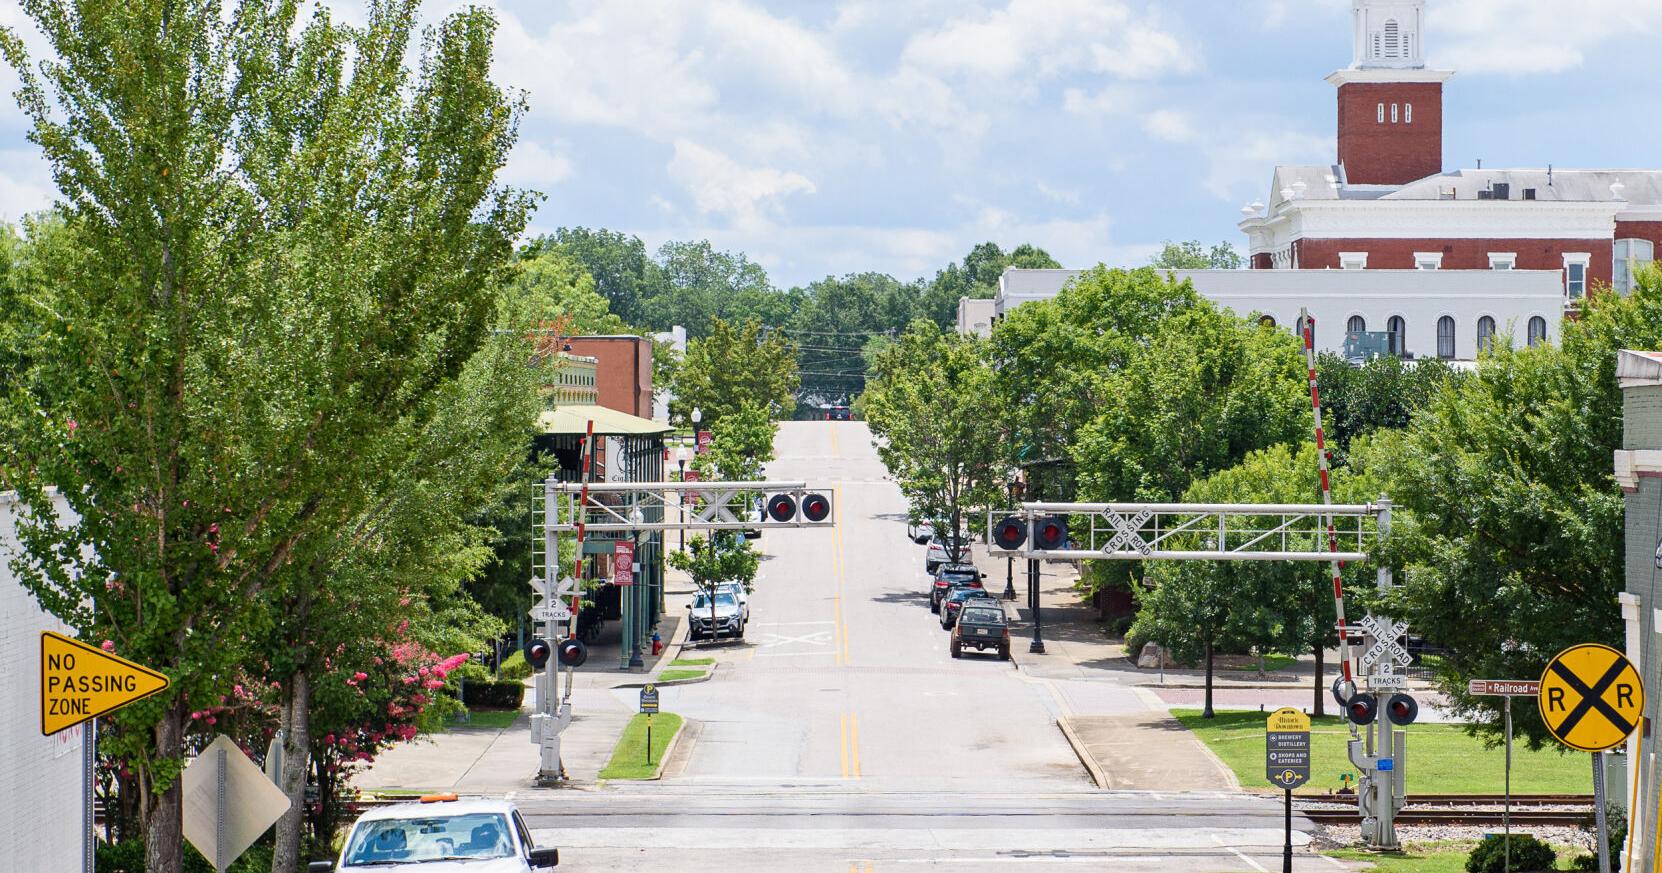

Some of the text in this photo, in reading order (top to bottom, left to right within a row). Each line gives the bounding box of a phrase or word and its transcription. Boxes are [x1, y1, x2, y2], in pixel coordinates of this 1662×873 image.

[1102, 507, 1151, 556] RAIL ROAD
[1104, 510, 1150, 555] CROSSING
[551, 600, 557, 608] 2
[1362, 616, 1411, 665] RAIL ROAD
[48, 653, 76, 671] NO
[1383, 664, 1390, 674] 2
[48, 675, 137, 693] PASSING
[1373, 677, 1401, 685] TRACKS
[1493, 682, 1528, 693] Railroad
[49, 698, 91, 715] ZONE
[1548, 683, 1635, 712] R R
